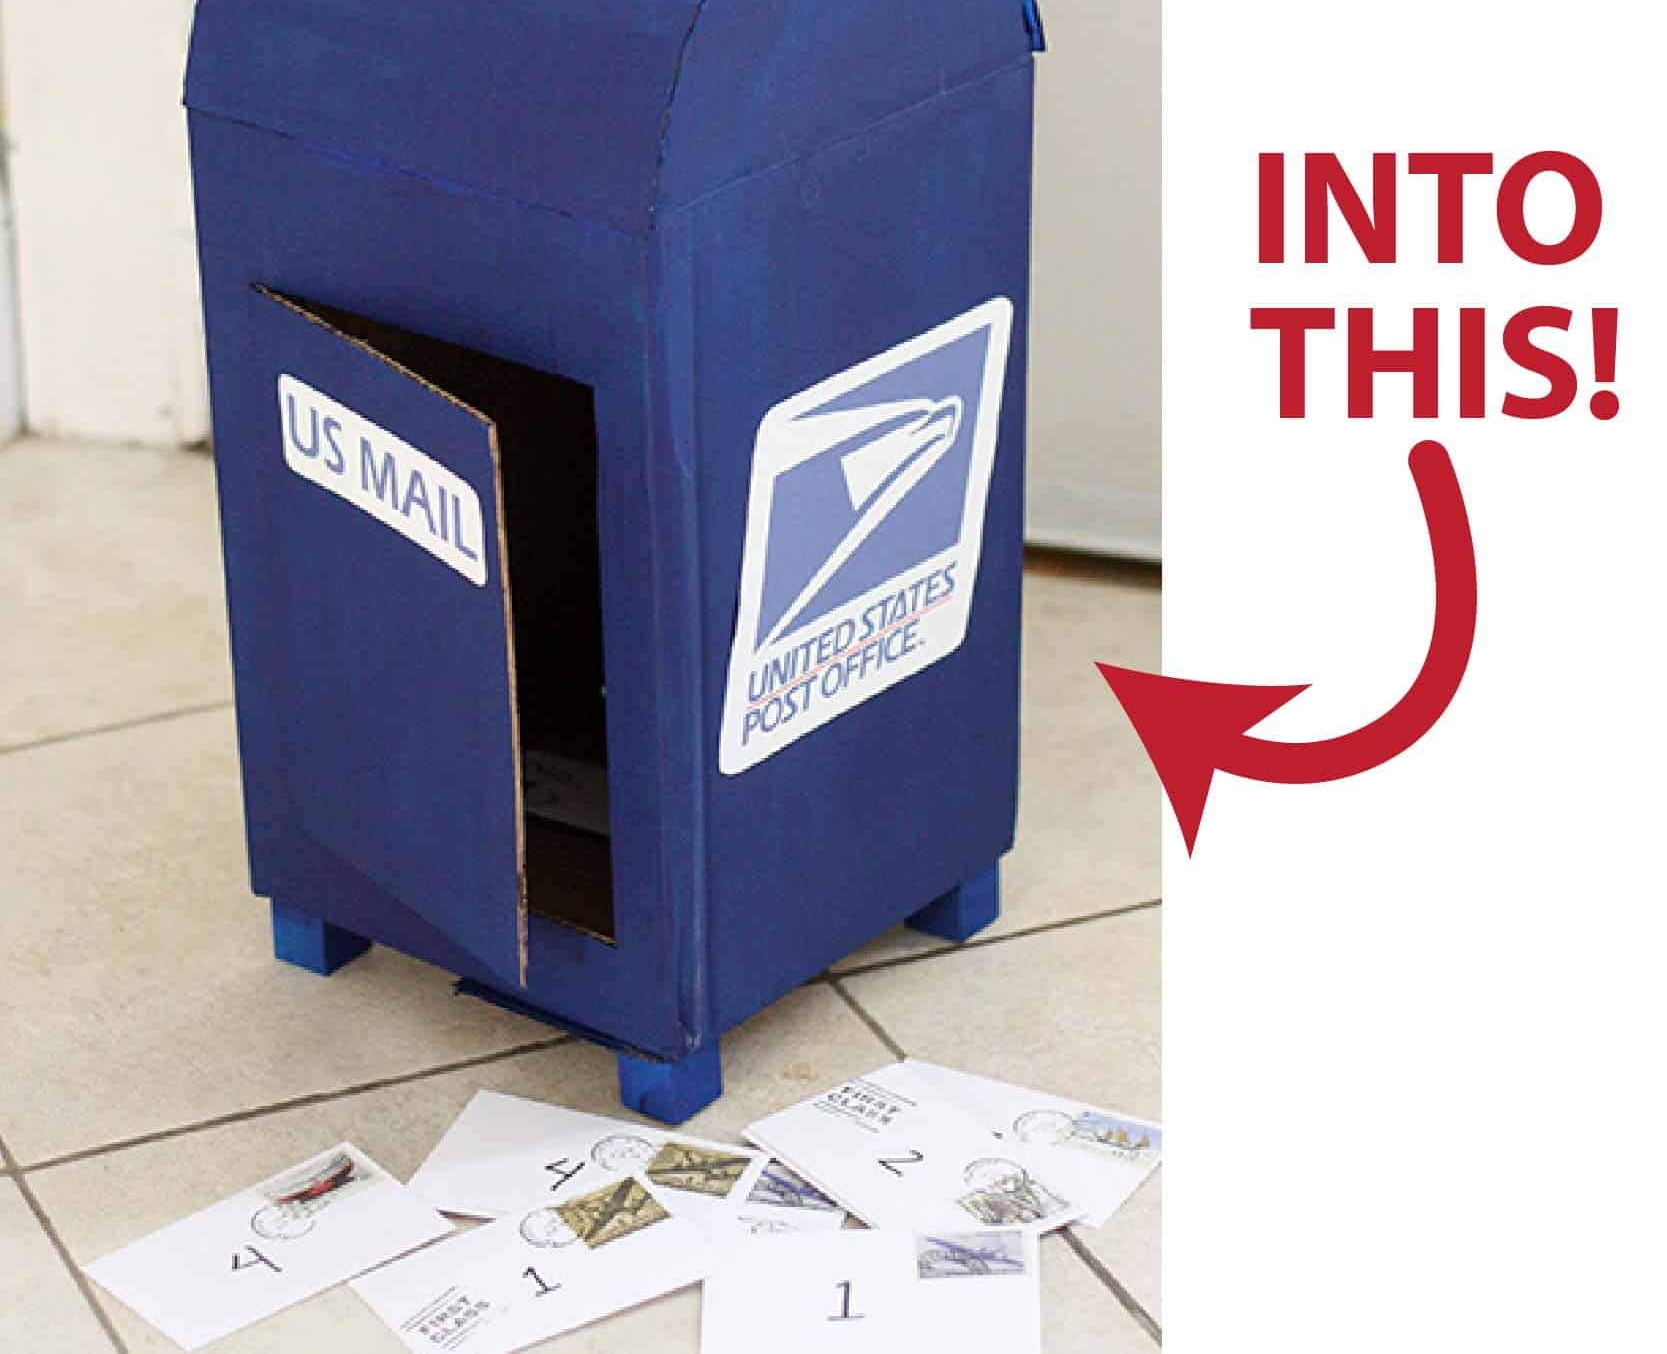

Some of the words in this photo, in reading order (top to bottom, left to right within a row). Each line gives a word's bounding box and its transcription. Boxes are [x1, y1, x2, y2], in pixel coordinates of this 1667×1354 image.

[287, 392, 347, 476] US
[359, 436, 479, 563] MAIL
[747, 618, 855, 702] UNITED
[859, 560, 959, 639] STATES
[741, 678, 815, 747] POST
[876, 1148, 925, 1178] 2
[231, 1245, 282, 1273] 4
[522, 1266, 562, 1298] 1
[827, 1279, 865, 1321] 1
